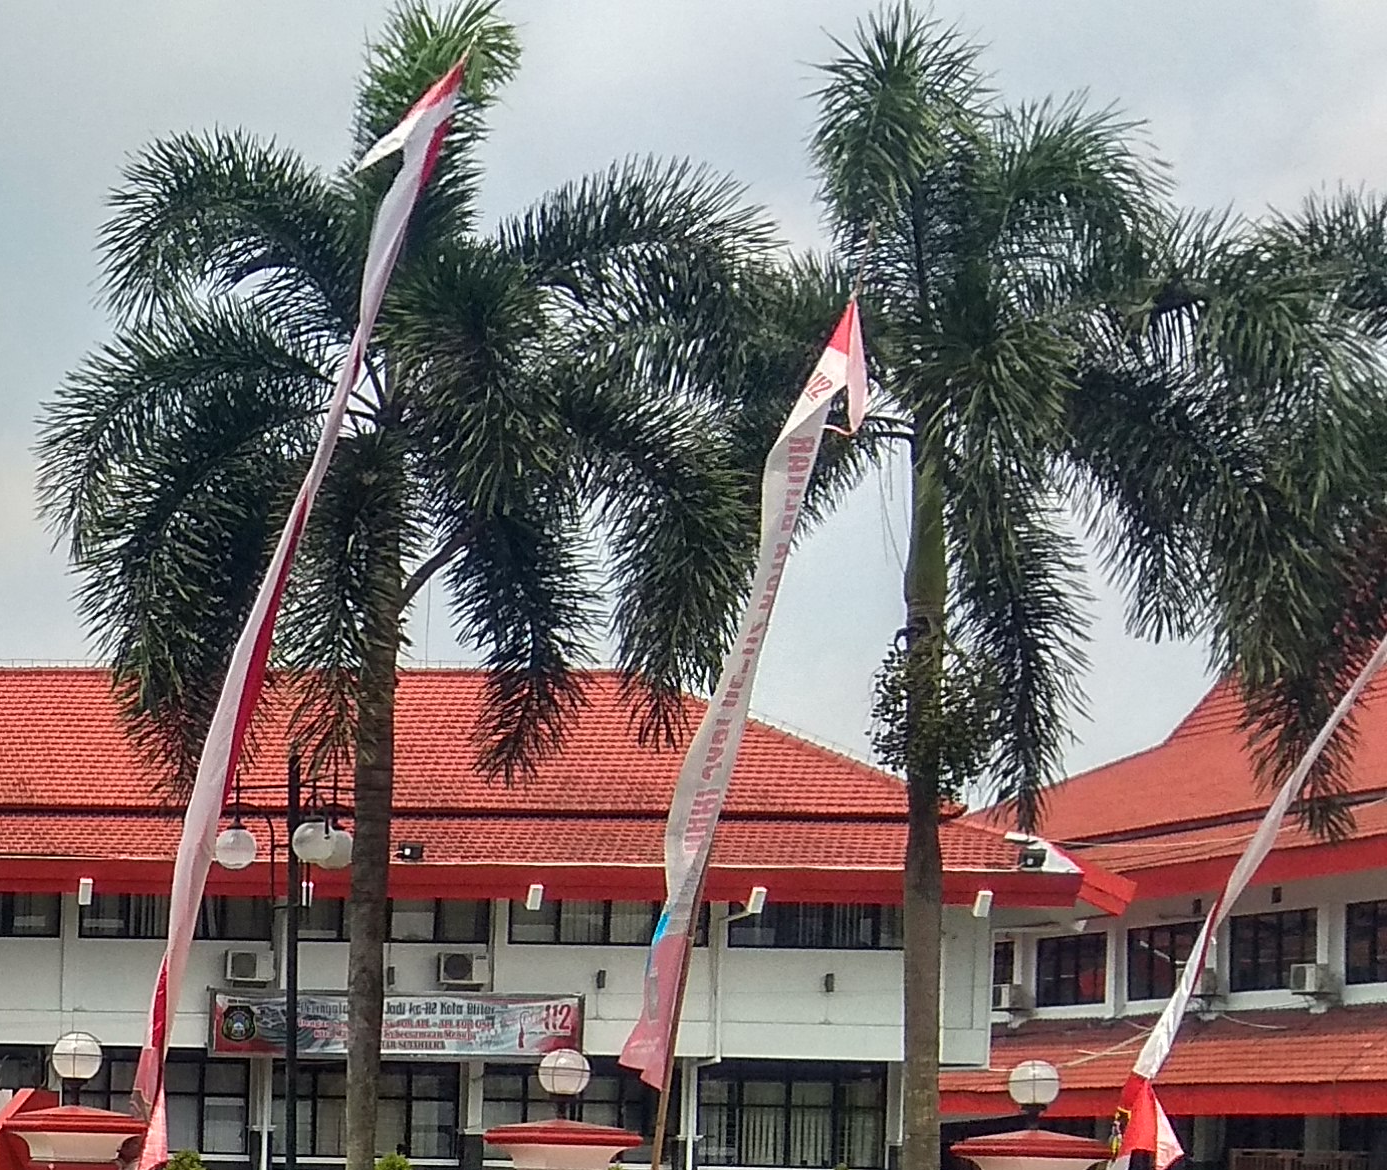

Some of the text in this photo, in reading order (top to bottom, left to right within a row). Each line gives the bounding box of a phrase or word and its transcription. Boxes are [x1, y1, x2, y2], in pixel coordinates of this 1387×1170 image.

[384, 1002, 405, 1015] Jadi
[440, 1003, 464, 1015] Kota
[467, 1003, 495, 1015] Blitar
[545, 1004, 571, 1030] 112
